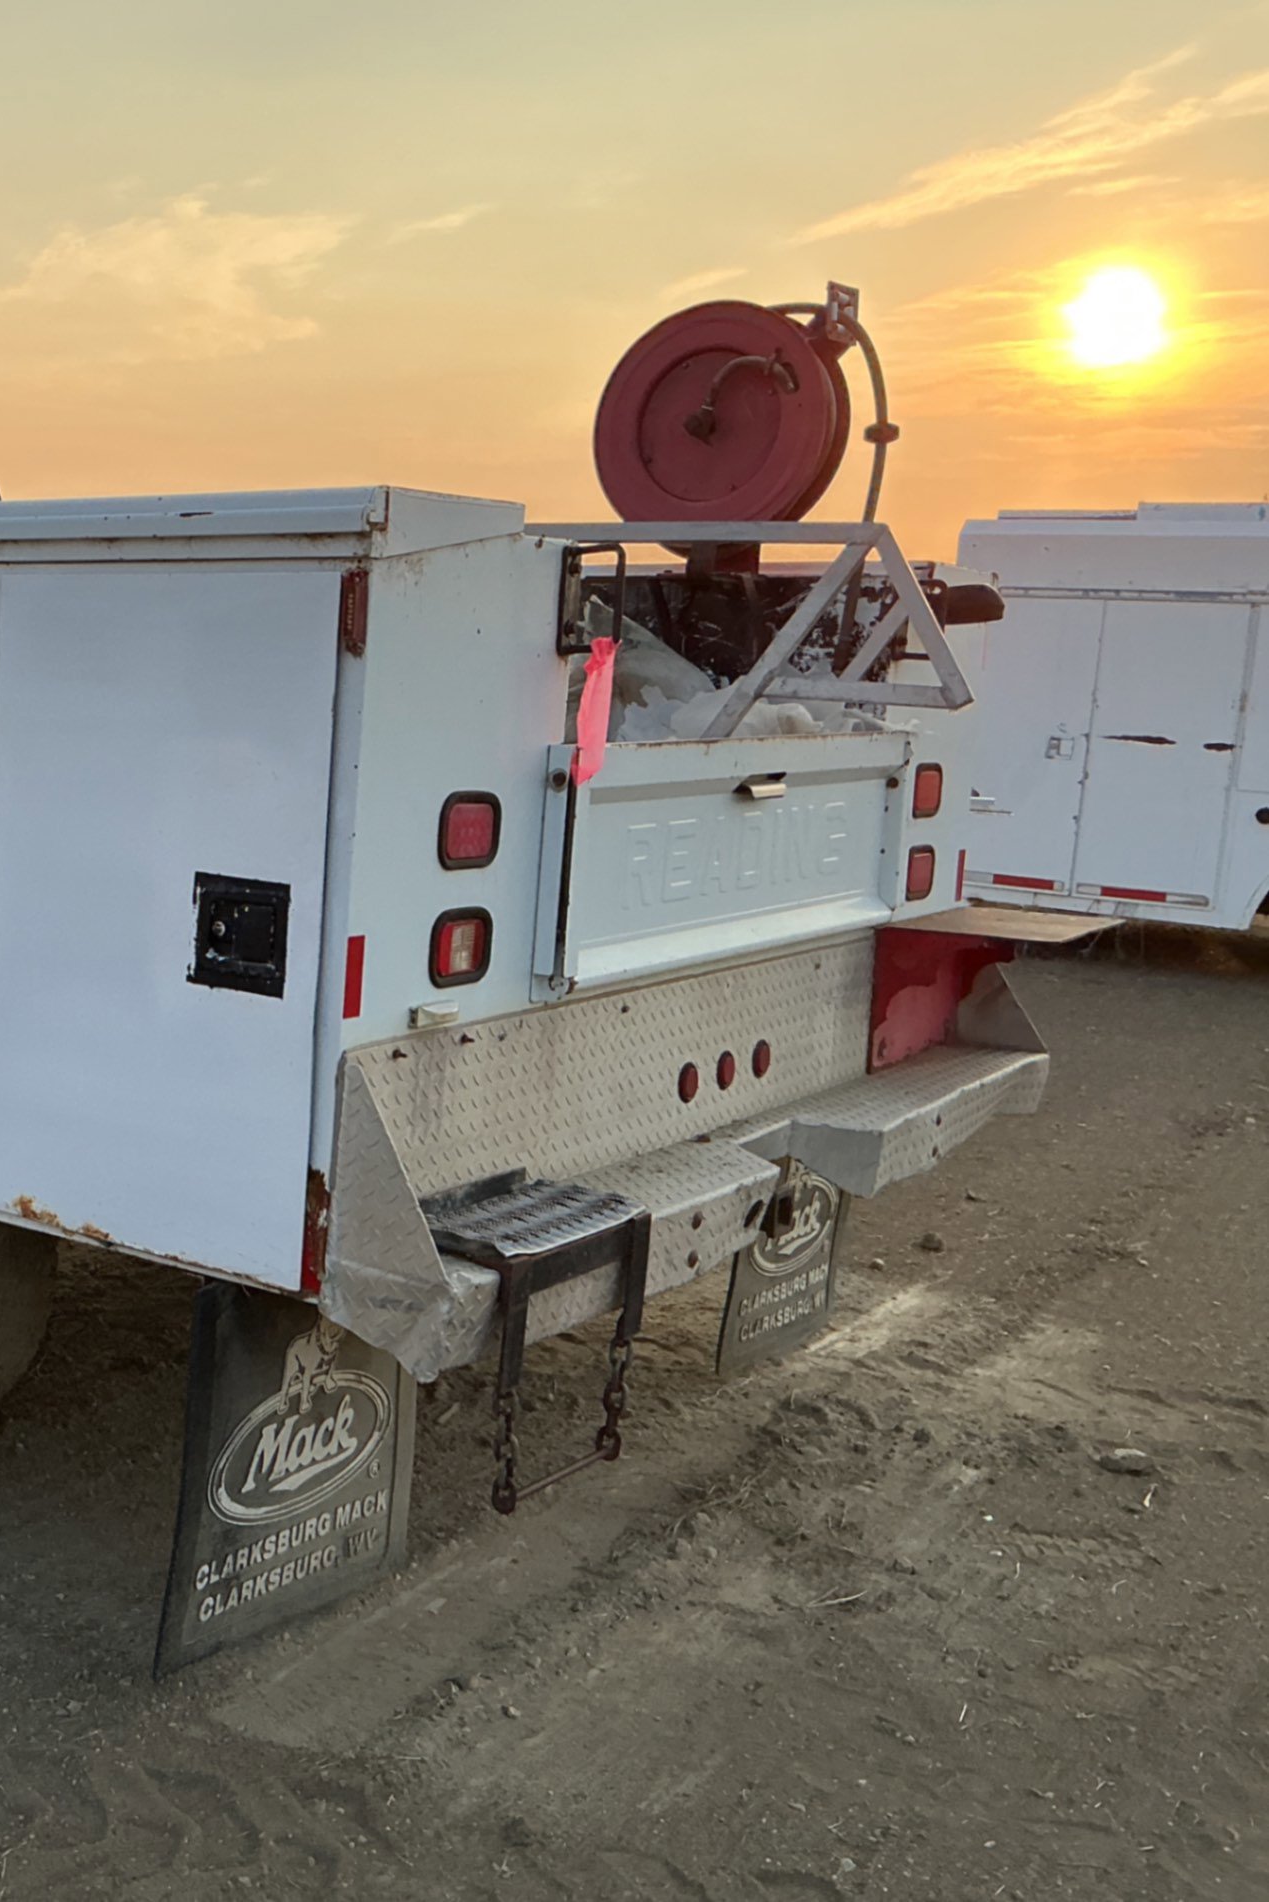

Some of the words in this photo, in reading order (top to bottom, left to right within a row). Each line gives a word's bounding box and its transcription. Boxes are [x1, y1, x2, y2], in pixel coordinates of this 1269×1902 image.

[621, 801, 847, 911] READING
[740, 1272, 807, 1317] CLARKSBURG
[241, 1393, 358, 1494] Mack
[194, 1512, 331, 1591] CLARKSBURG
[335, 1488, 389, 1531] MACK
[347, 1527, 378, 1557] WV
